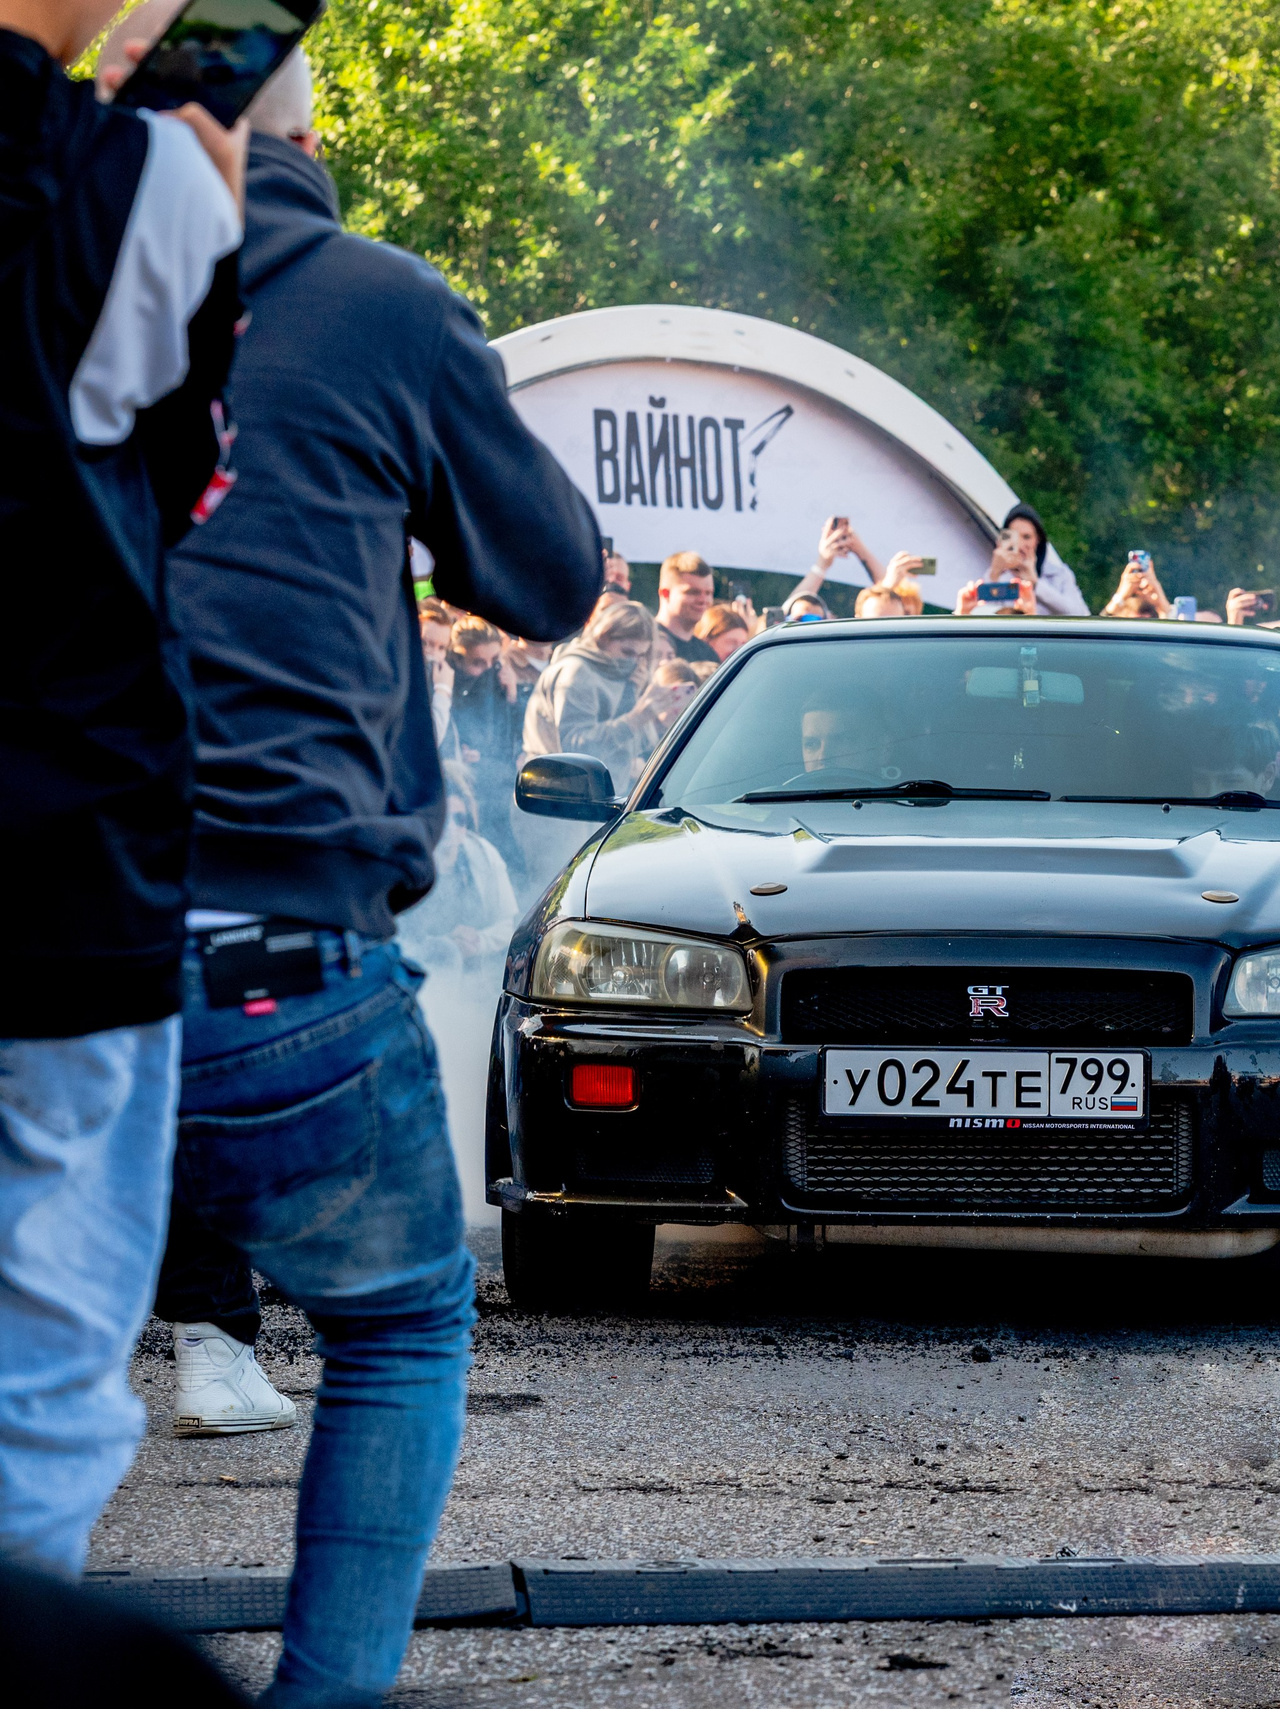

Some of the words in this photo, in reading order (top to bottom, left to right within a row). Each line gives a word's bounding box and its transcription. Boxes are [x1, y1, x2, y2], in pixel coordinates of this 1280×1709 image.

[967, 985, 1010, 995] GT
[969, 995, 1009, 1017] R
[1055, 1057, 1131, 1096] 799
[1072, 1096, 1109, 1111] RUS
[949, 1118, 1021, 1128] nismo
